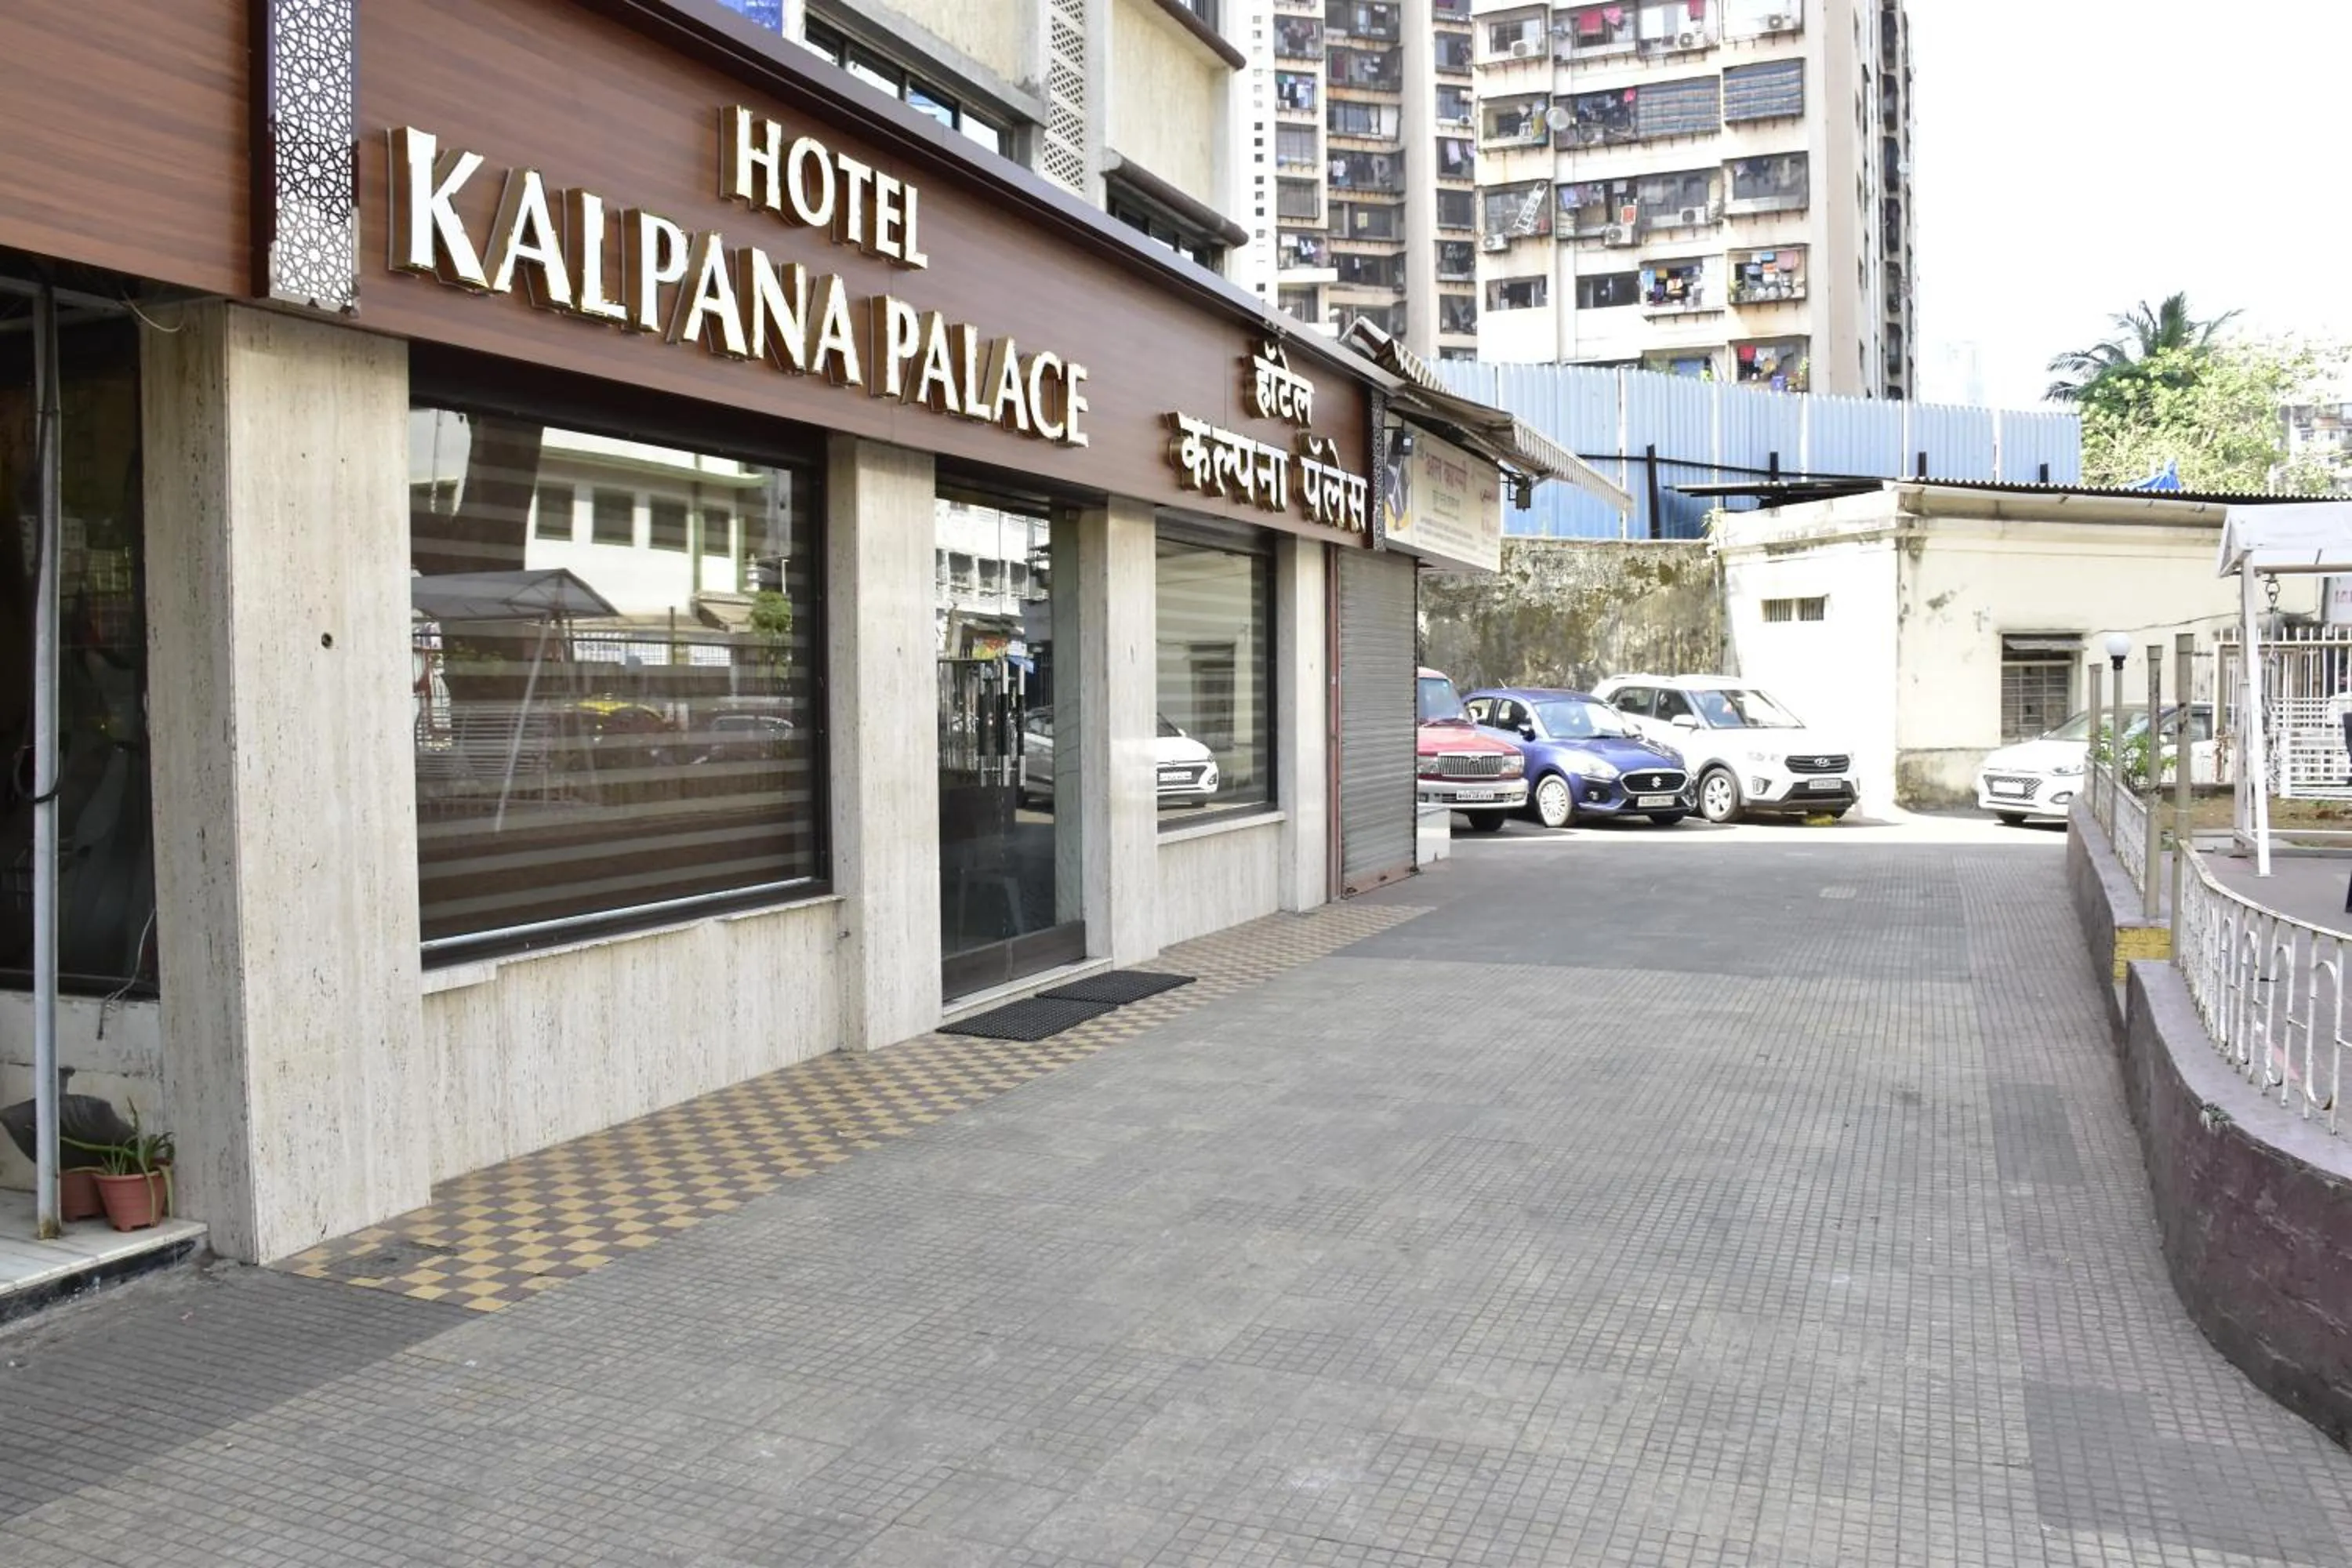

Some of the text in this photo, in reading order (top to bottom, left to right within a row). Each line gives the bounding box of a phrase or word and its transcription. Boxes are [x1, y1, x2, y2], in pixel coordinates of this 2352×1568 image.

[735, 104, 928, 269] HOTEL
[405, 125, 1089, 448] KALPANA PALACE
[1252, 340, 1315, 426] हॉटेल
[1176, 410, 1290, 508] कल्पना
[1299, 435, 1368, 532] पॅलेस
